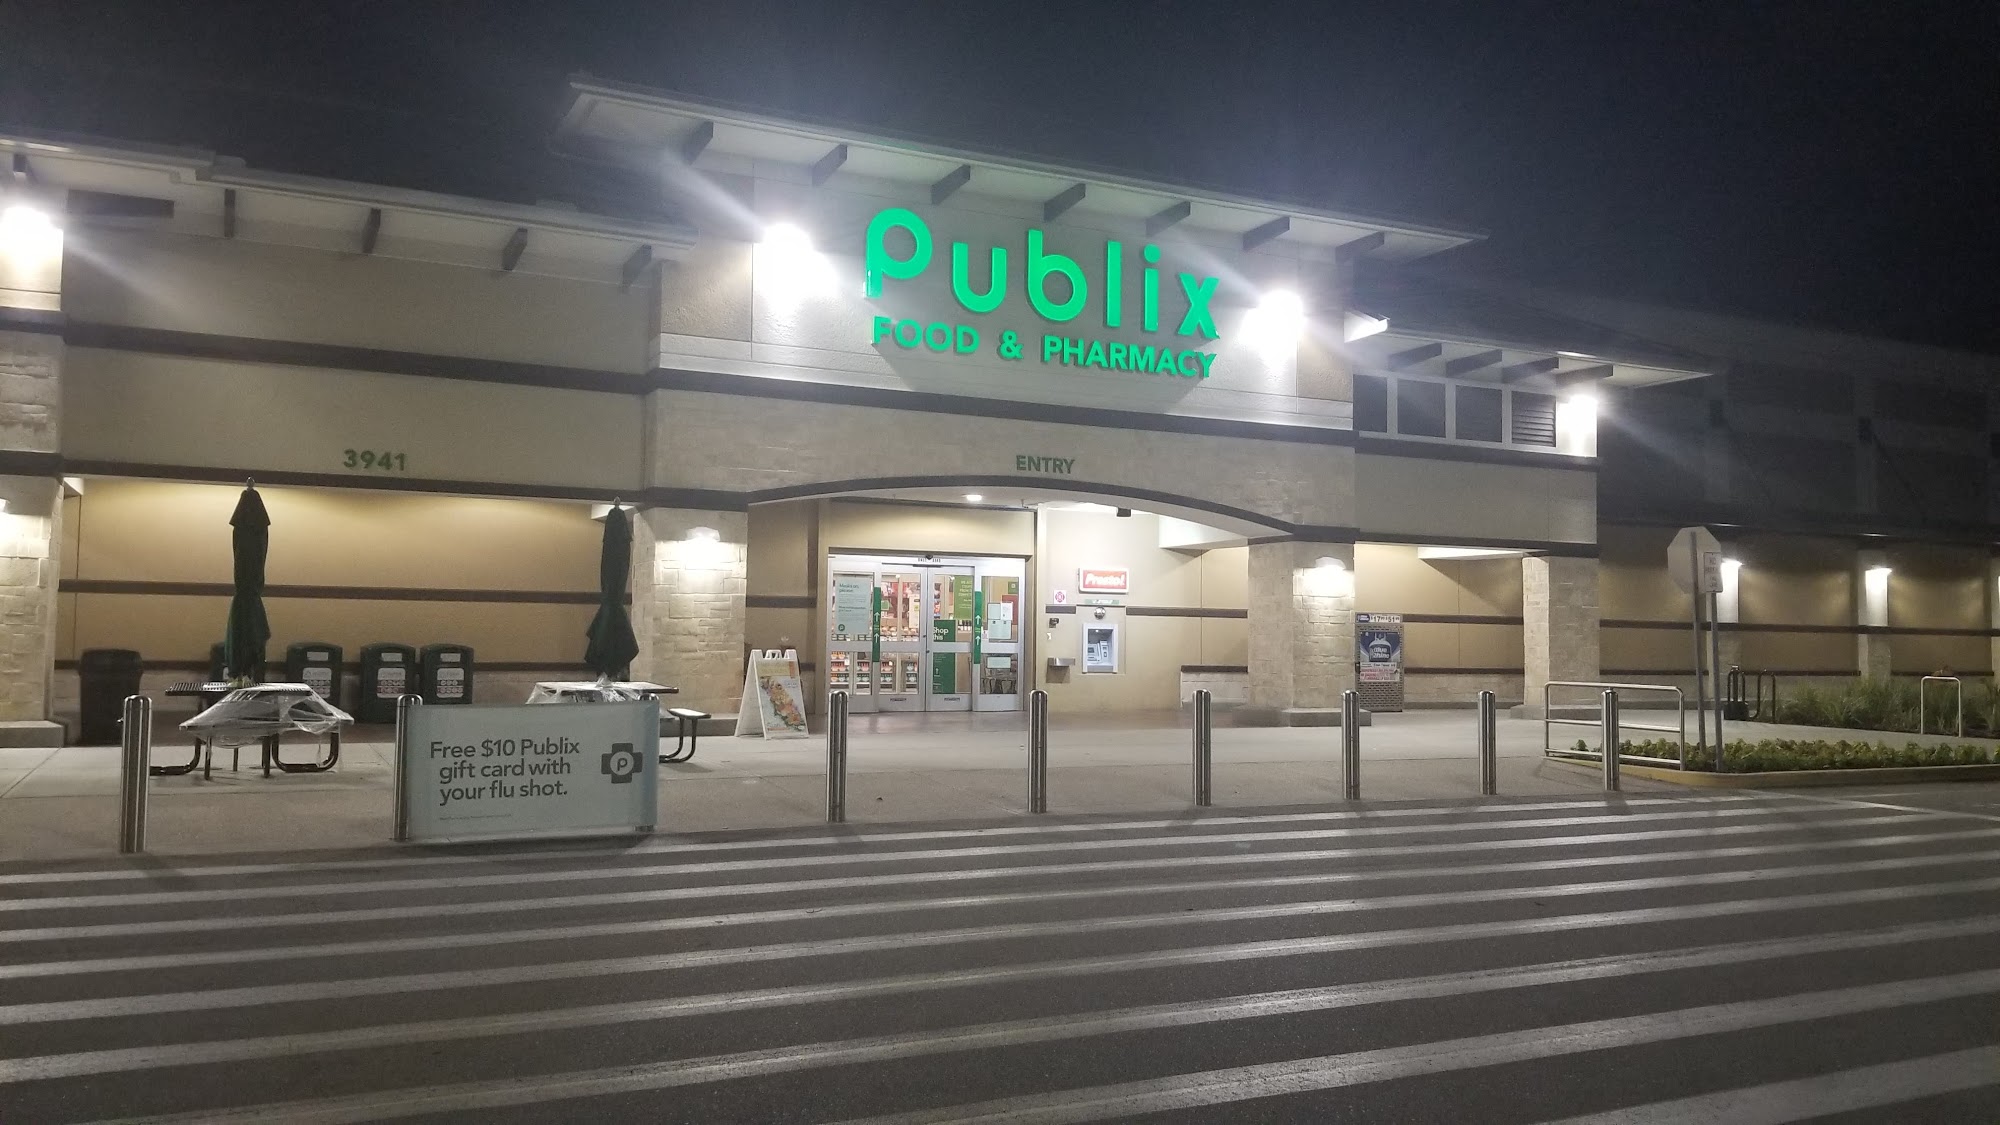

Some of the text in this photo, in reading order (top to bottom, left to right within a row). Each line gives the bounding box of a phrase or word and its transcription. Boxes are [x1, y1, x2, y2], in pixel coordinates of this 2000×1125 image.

[865, 207, 1220, 339] Publix
[871, 315, 1218, 379] FOOD & PHARMACY
[343, 448, 406, 471] 3941
[1016, 455, 1075, 474] ENTRY
[430, 737, 580, 759] Free $10 Publix
[439, 756, 571, 784] gift card with
[439, 779, 568, 807] your flu shot.
